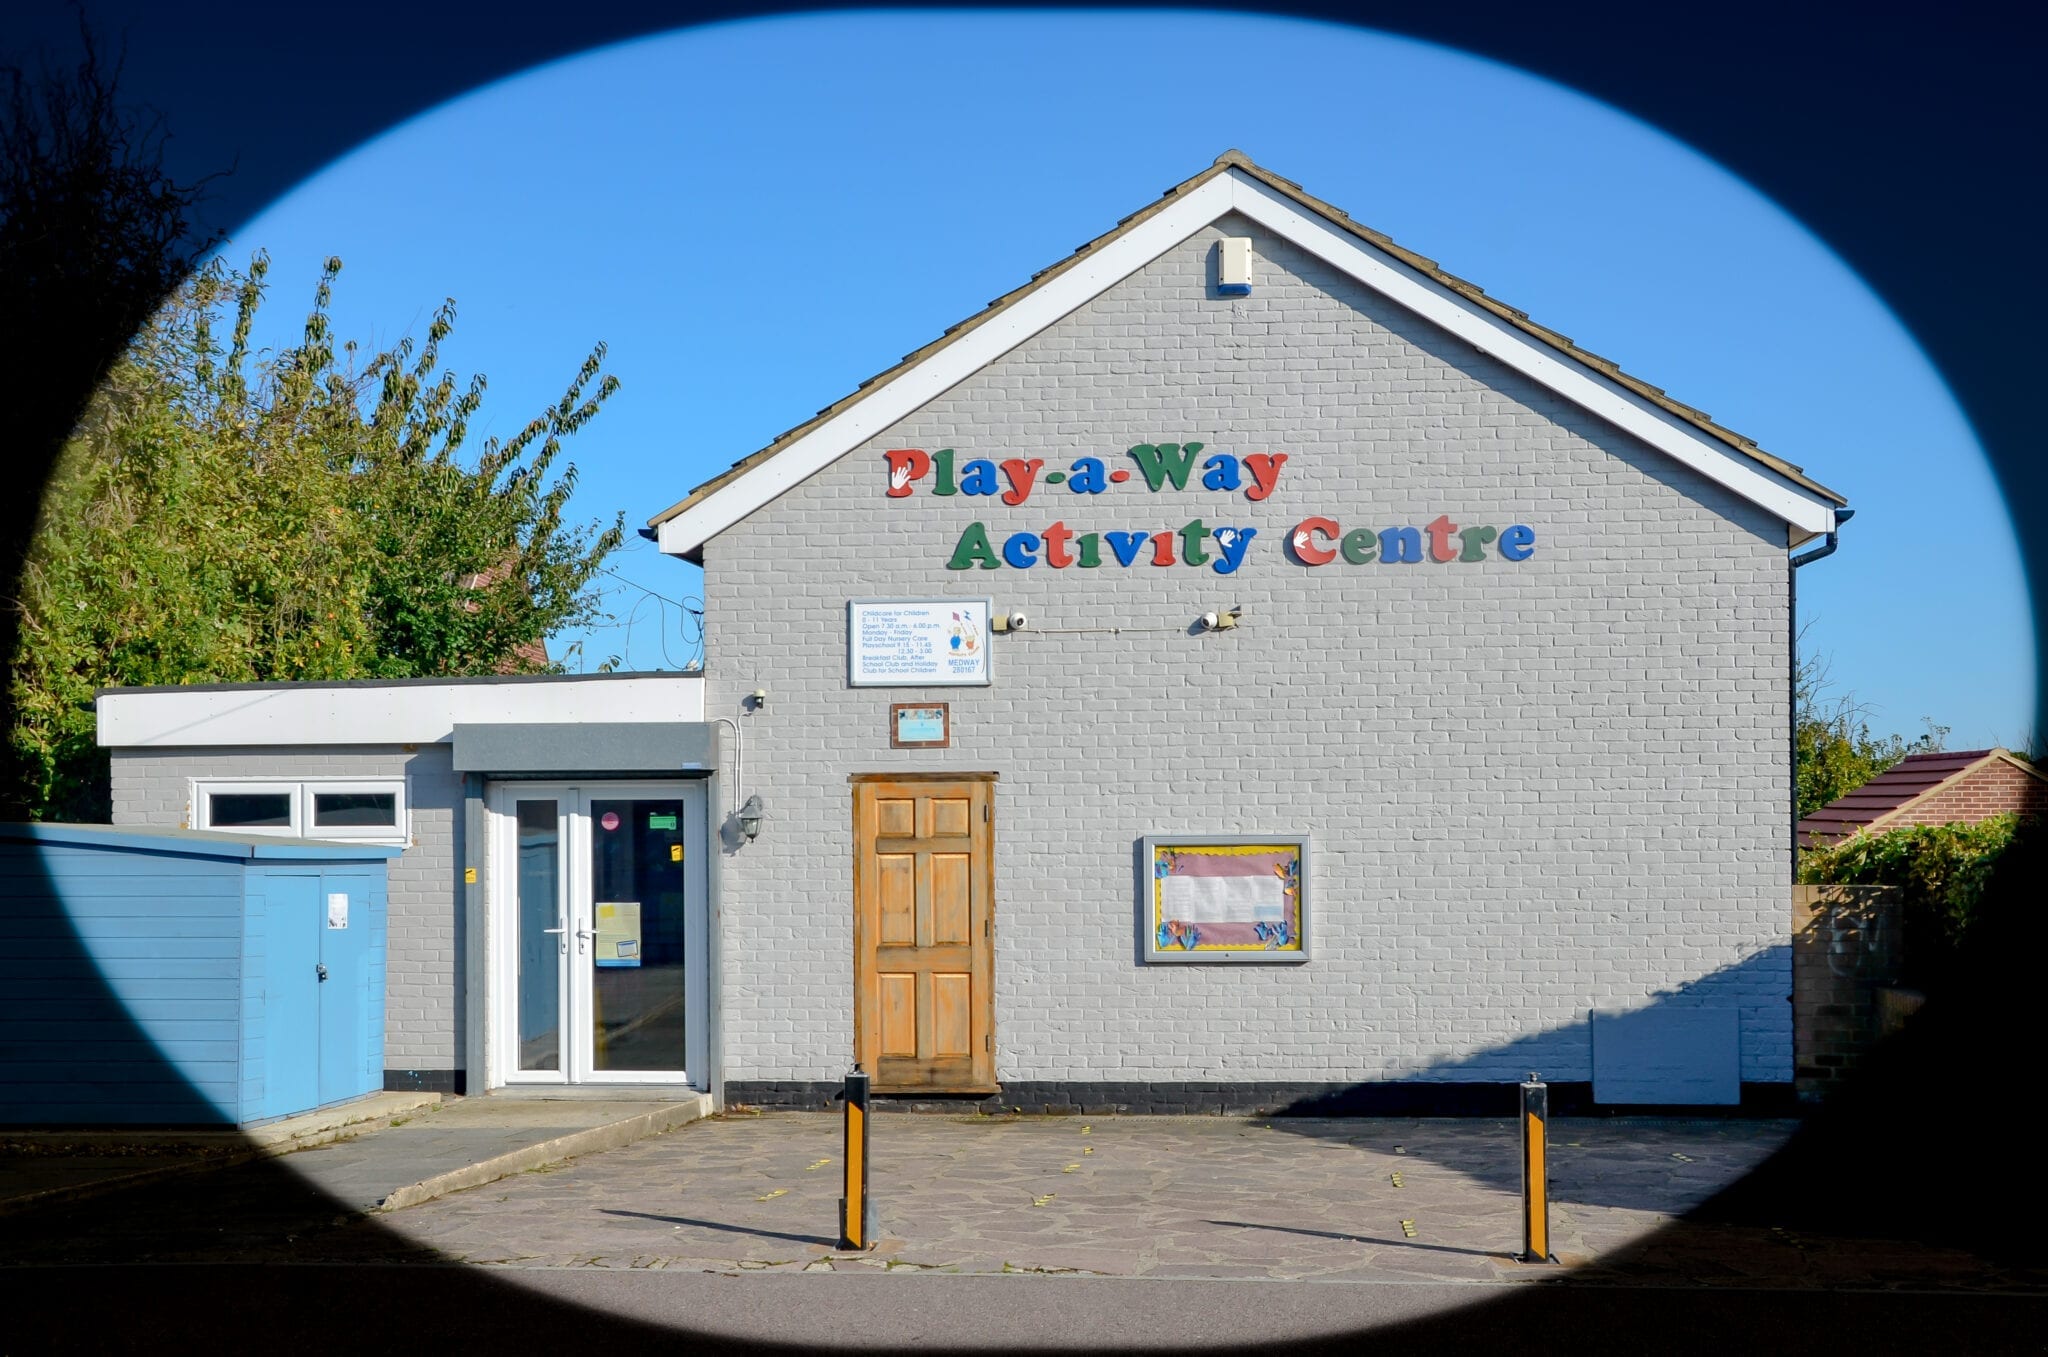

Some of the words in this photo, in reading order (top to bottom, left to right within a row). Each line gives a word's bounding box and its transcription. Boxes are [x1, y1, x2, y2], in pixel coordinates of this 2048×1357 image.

[886, 442, 1289, 505] Play-a-Way
[947, 519, 1257, 574] Activity
[1292, 515, 1535, 566] Centre
